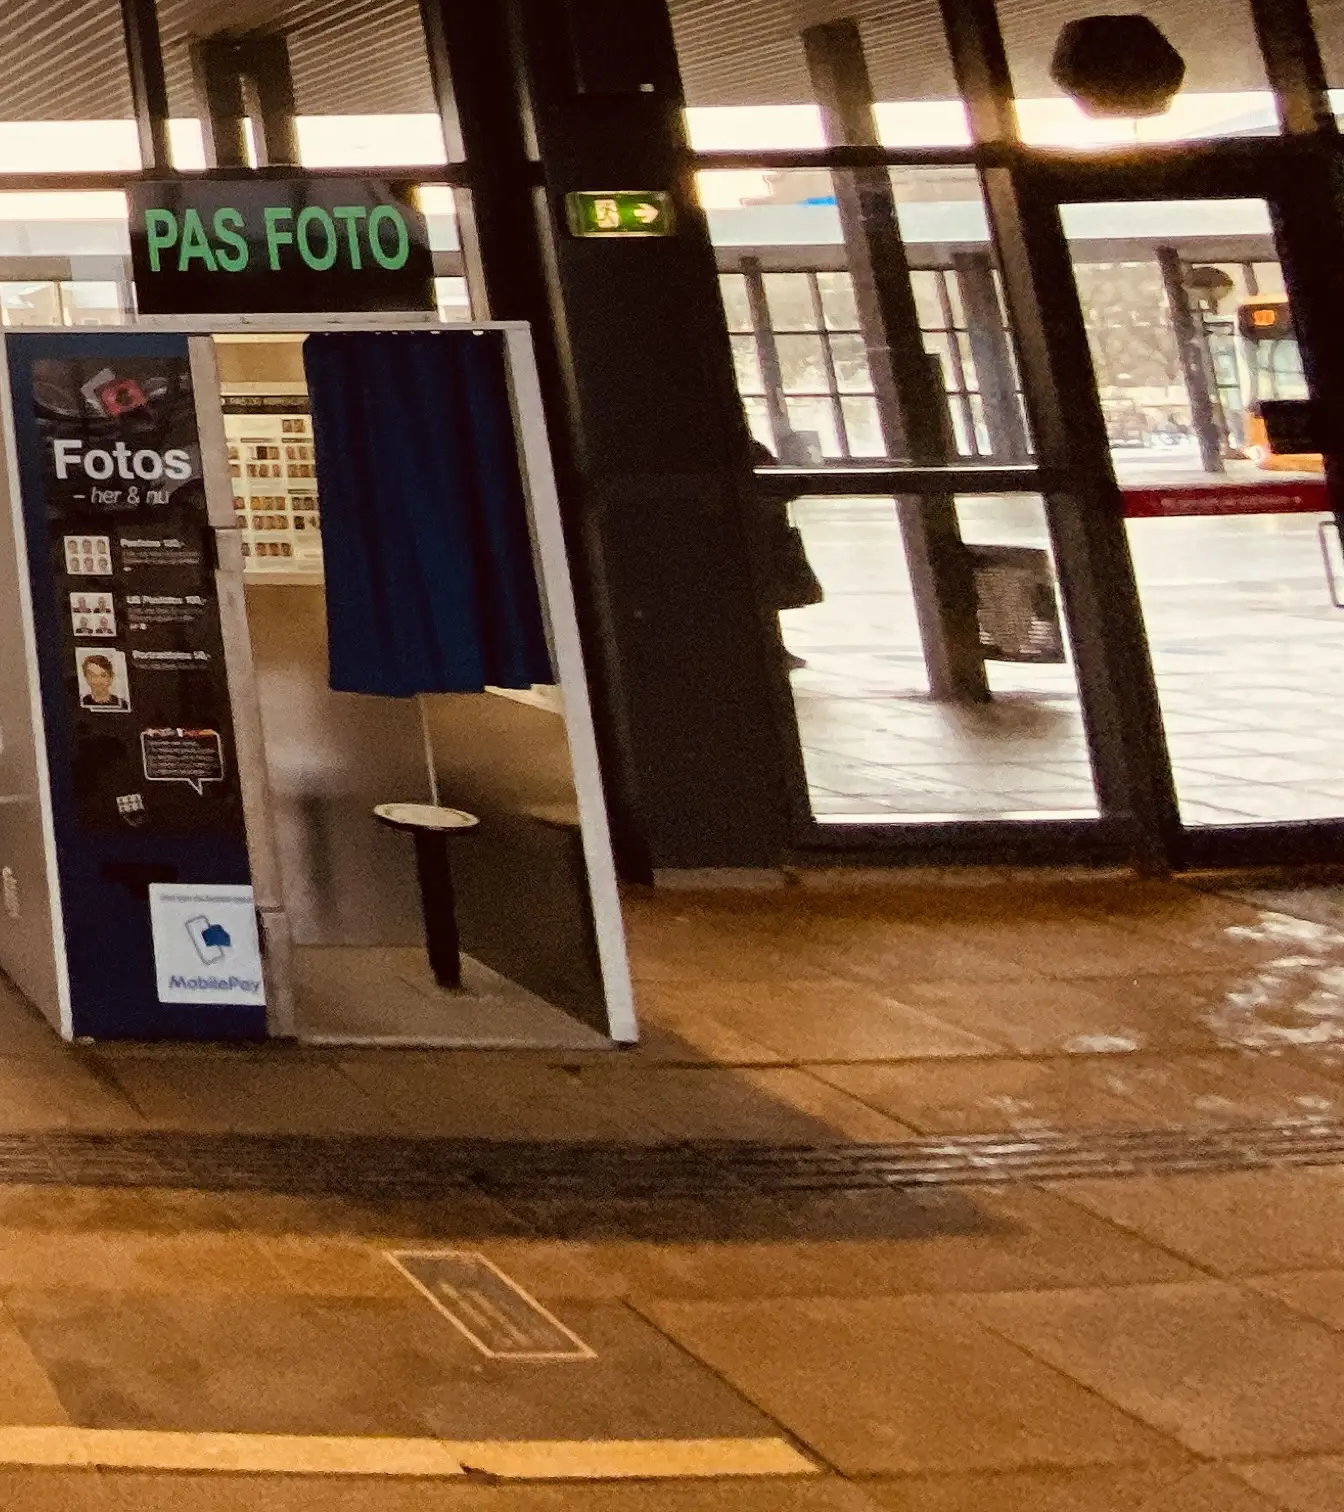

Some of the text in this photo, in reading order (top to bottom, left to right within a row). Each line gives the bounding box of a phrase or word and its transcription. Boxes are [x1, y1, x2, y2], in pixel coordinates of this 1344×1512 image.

[144, 204, 410, 272] PAS FOTO
[53, 439, 192, 480] Fotos
[90, 486, 122, 504] her
[127, 485, 140, 505] &
[146, 490, 169, 504] nu
[169, 975, 260, 993] MobilePay
